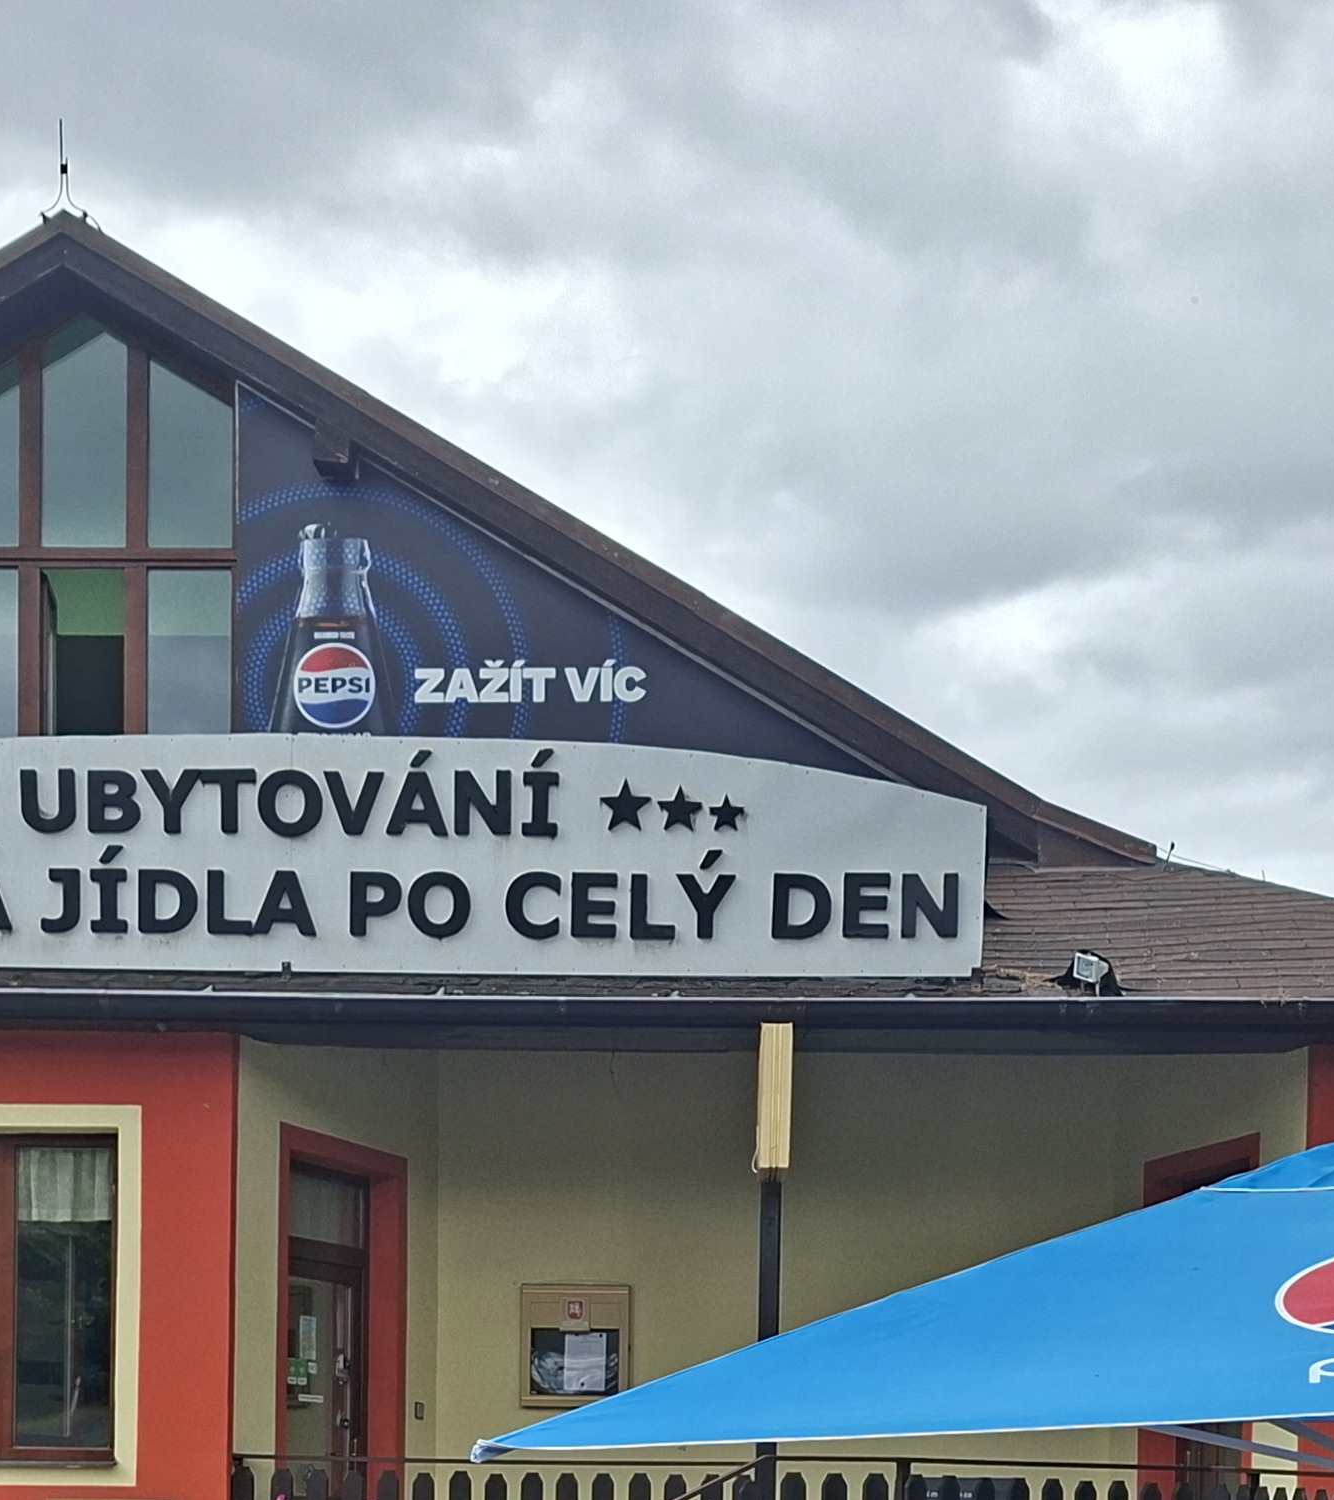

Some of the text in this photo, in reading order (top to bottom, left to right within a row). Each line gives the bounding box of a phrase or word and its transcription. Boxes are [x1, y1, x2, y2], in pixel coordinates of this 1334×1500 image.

[297, 676, 371, 694] PEPSI
[414, 659, 647, 703] ZAŽÍT VÍC
[19, 749, 560, 838] UBYTOVÁNÍ
[40, 845, 316, 936] JÍDLA
[349, 871, 472, 939] PO
[505, 849, 736, 940] CELÝ
[771, 872, 959, 940] DEN
